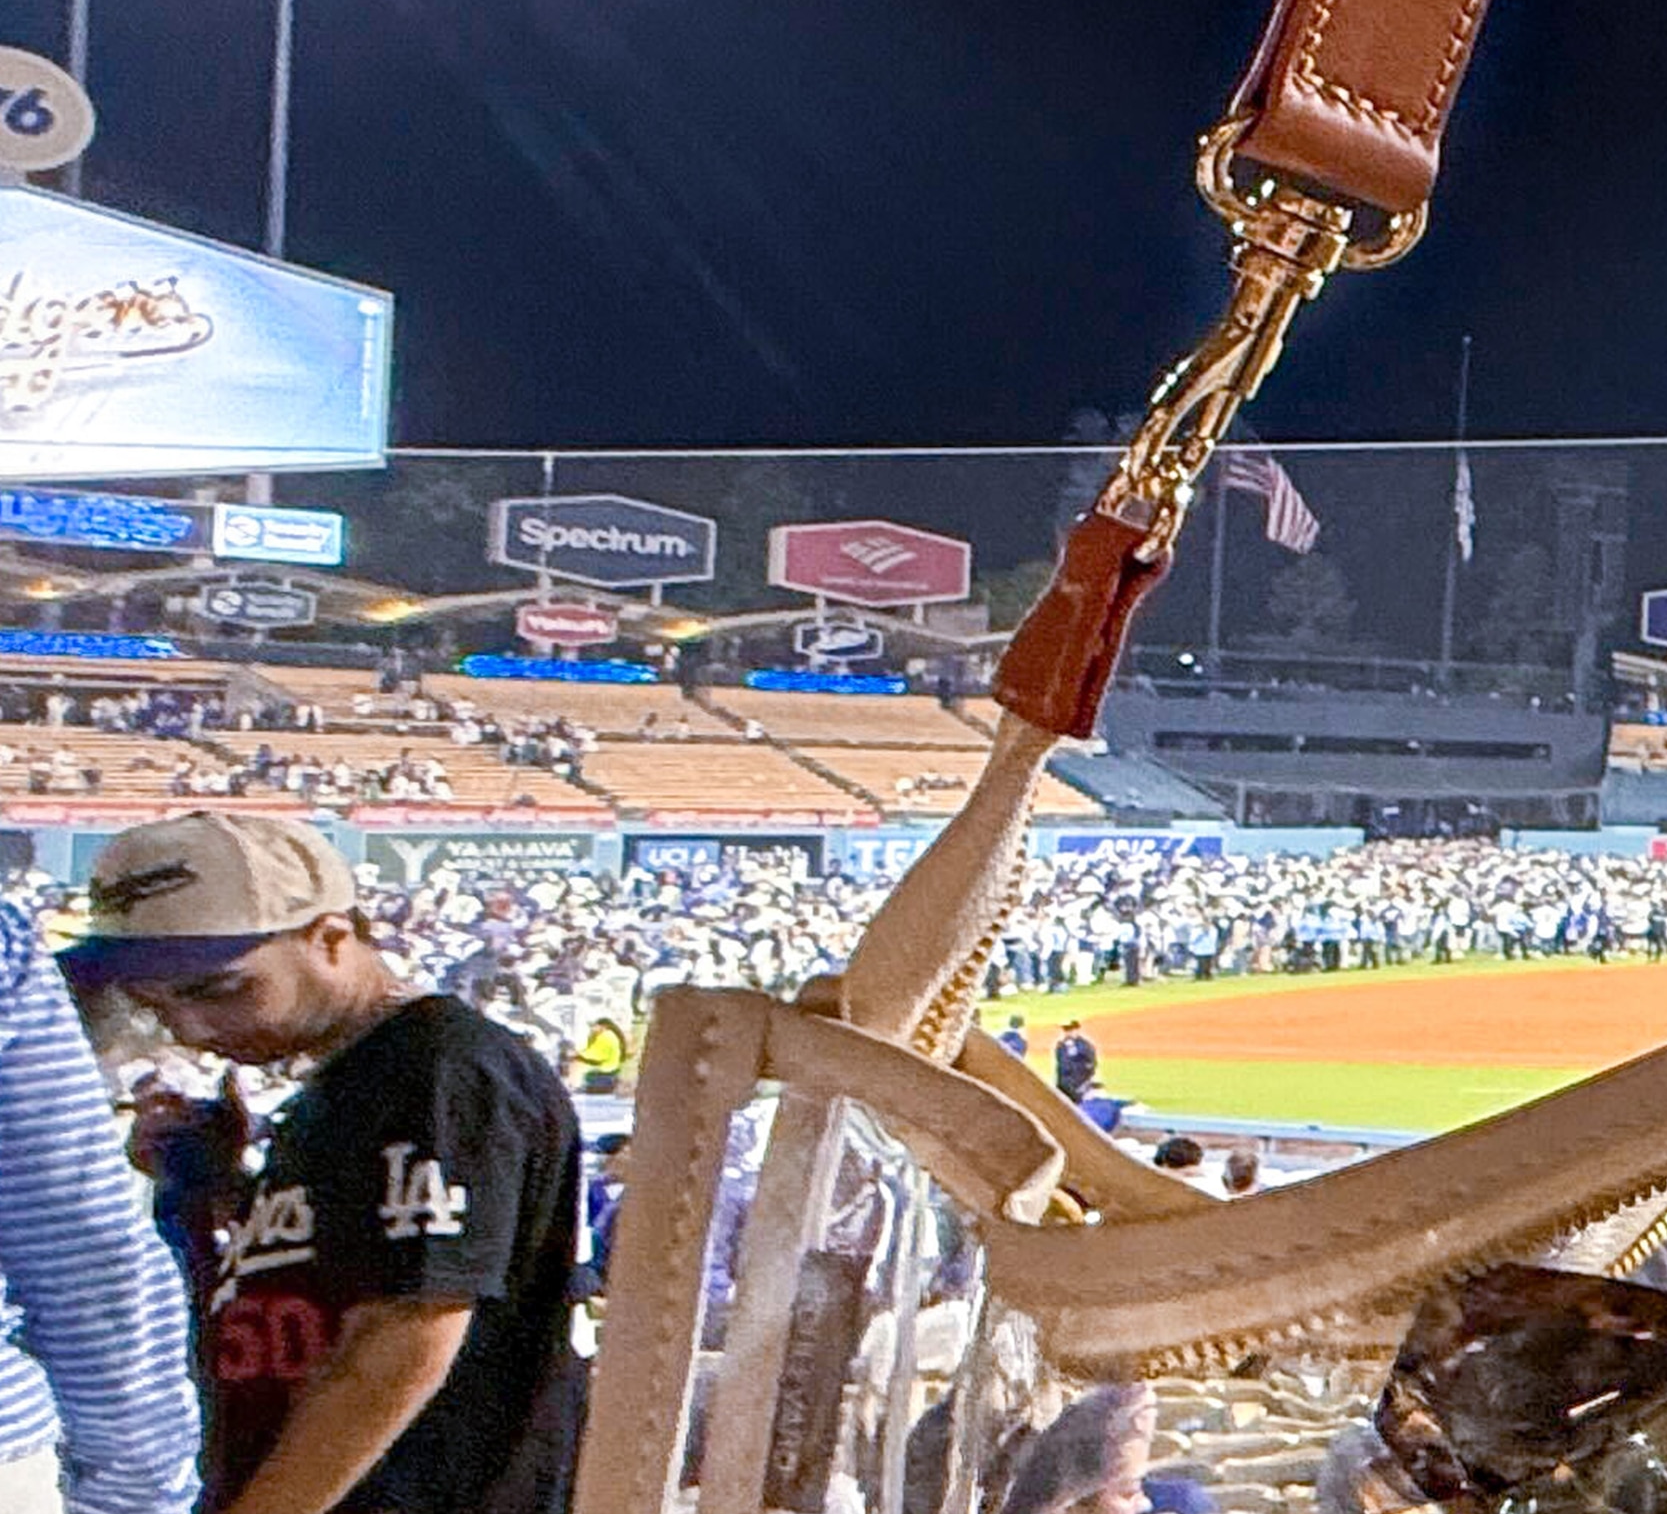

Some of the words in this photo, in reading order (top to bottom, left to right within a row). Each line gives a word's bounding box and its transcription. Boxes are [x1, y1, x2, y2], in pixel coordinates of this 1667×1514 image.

[0, 87, 55, 136] 6
[520, 518, 688, 558] Spectrum
[378, 1140, 467, 1238] LA
